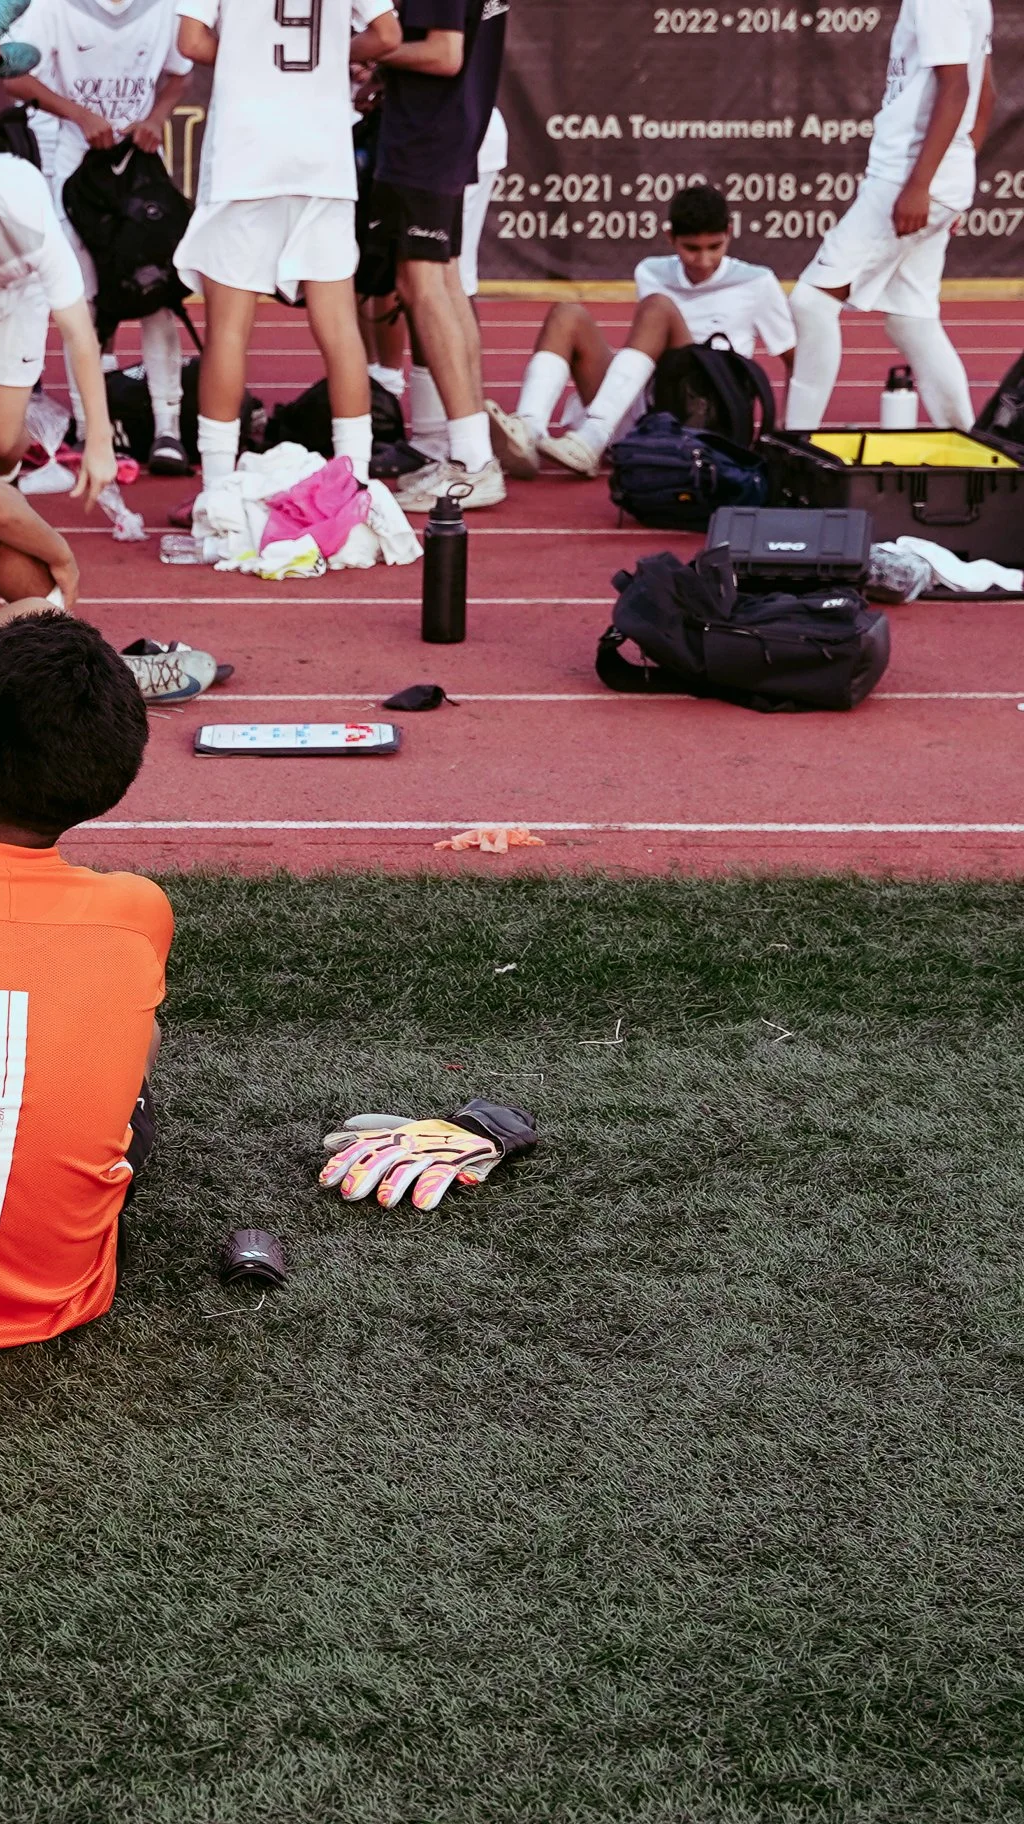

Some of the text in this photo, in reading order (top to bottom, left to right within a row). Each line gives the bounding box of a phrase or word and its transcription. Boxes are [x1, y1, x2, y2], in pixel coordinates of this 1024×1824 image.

[274, 0, 321, 71] 9
[654, 8, 881, 34] 2022 2014 2009
[546, 113, 874, 144] CCAA Tournament Appe
[490, 173, 525, 202] 22
[544, 173, 613, 202] 2021
[726, 172, 797, 202] 2018
[497, 211, 569, 239] 2014
[587, 211, 658, 239] 2013
